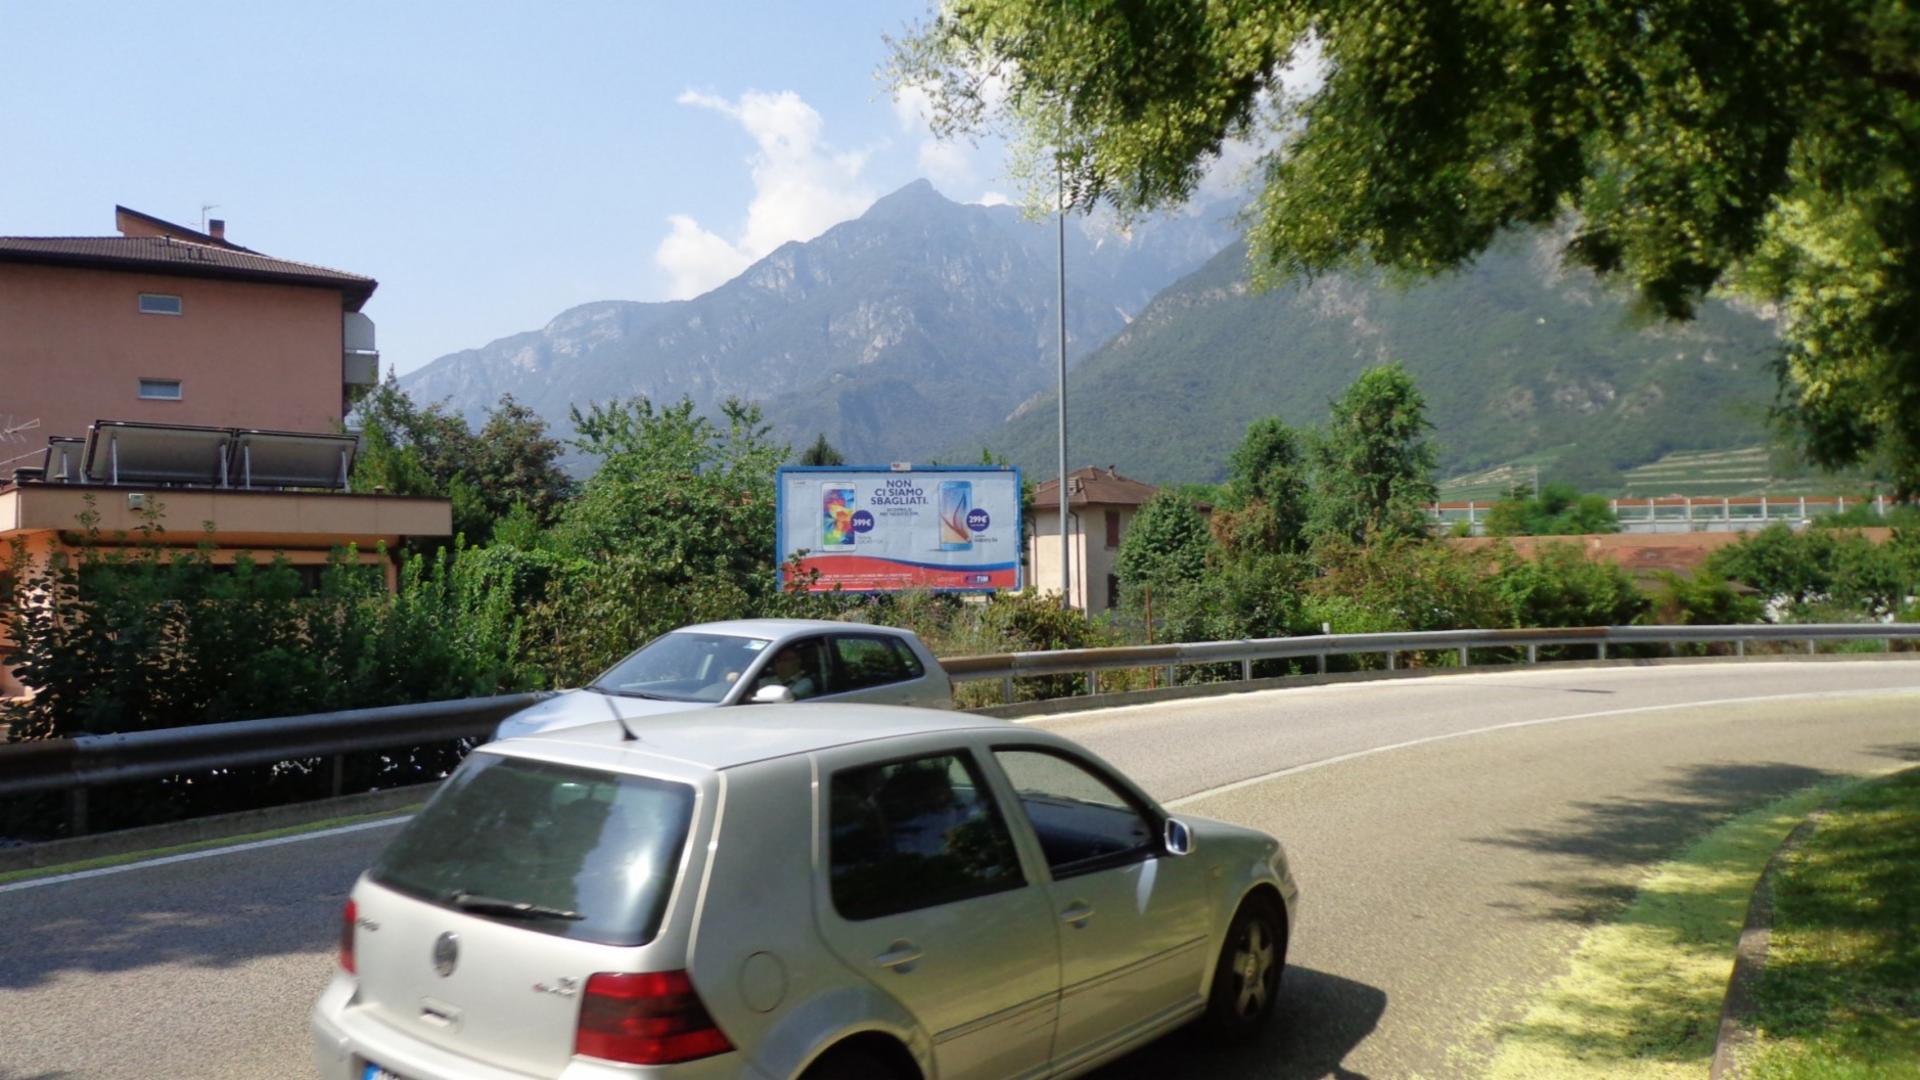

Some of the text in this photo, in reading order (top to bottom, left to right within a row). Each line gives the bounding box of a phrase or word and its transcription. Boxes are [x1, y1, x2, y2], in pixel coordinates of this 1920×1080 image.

[886, 480, 912, 488] NON
[874, 488, 924, 497] CI SIAMO
[871, 496, 929, 505] SBAGLIATI.
